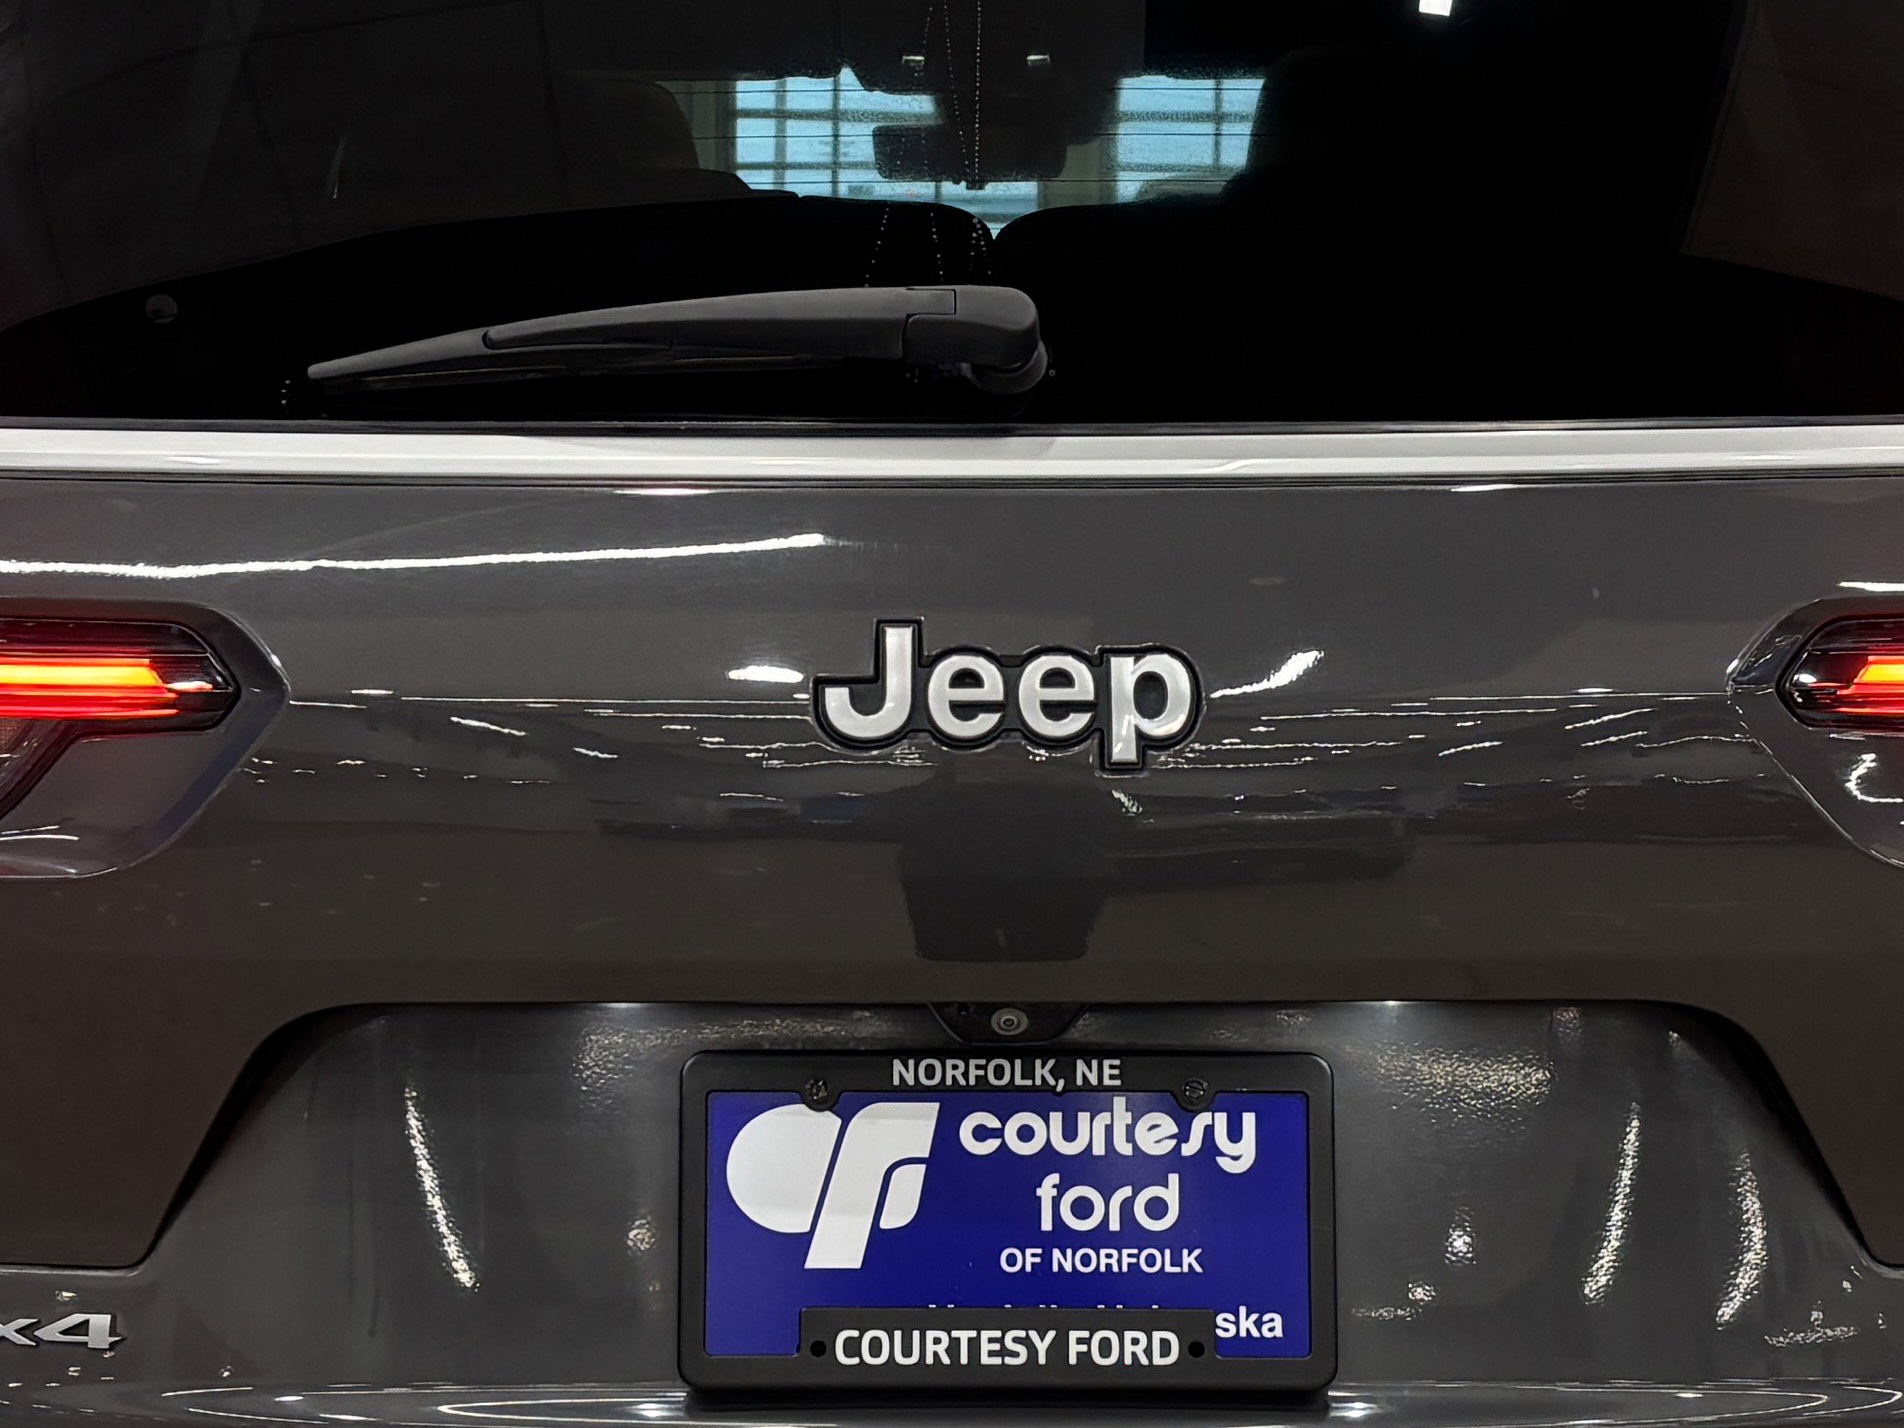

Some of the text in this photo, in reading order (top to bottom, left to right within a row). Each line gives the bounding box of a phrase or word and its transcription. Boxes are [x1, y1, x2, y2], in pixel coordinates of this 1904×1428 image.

[823, 625, 1193, 765] Jeep
[891, 1058, 1122, 1092] NORFOLK, NE
[958, 1096, 1256, 1174] courtesy
[1035, 1172, 1180, 1232] ford
[999, 1247, 1203, 1274] OF NORFOLK
[1215, 1305, 1284, 1339] ska
[834, 1328, 1181, 1367] COURTESY FORD
